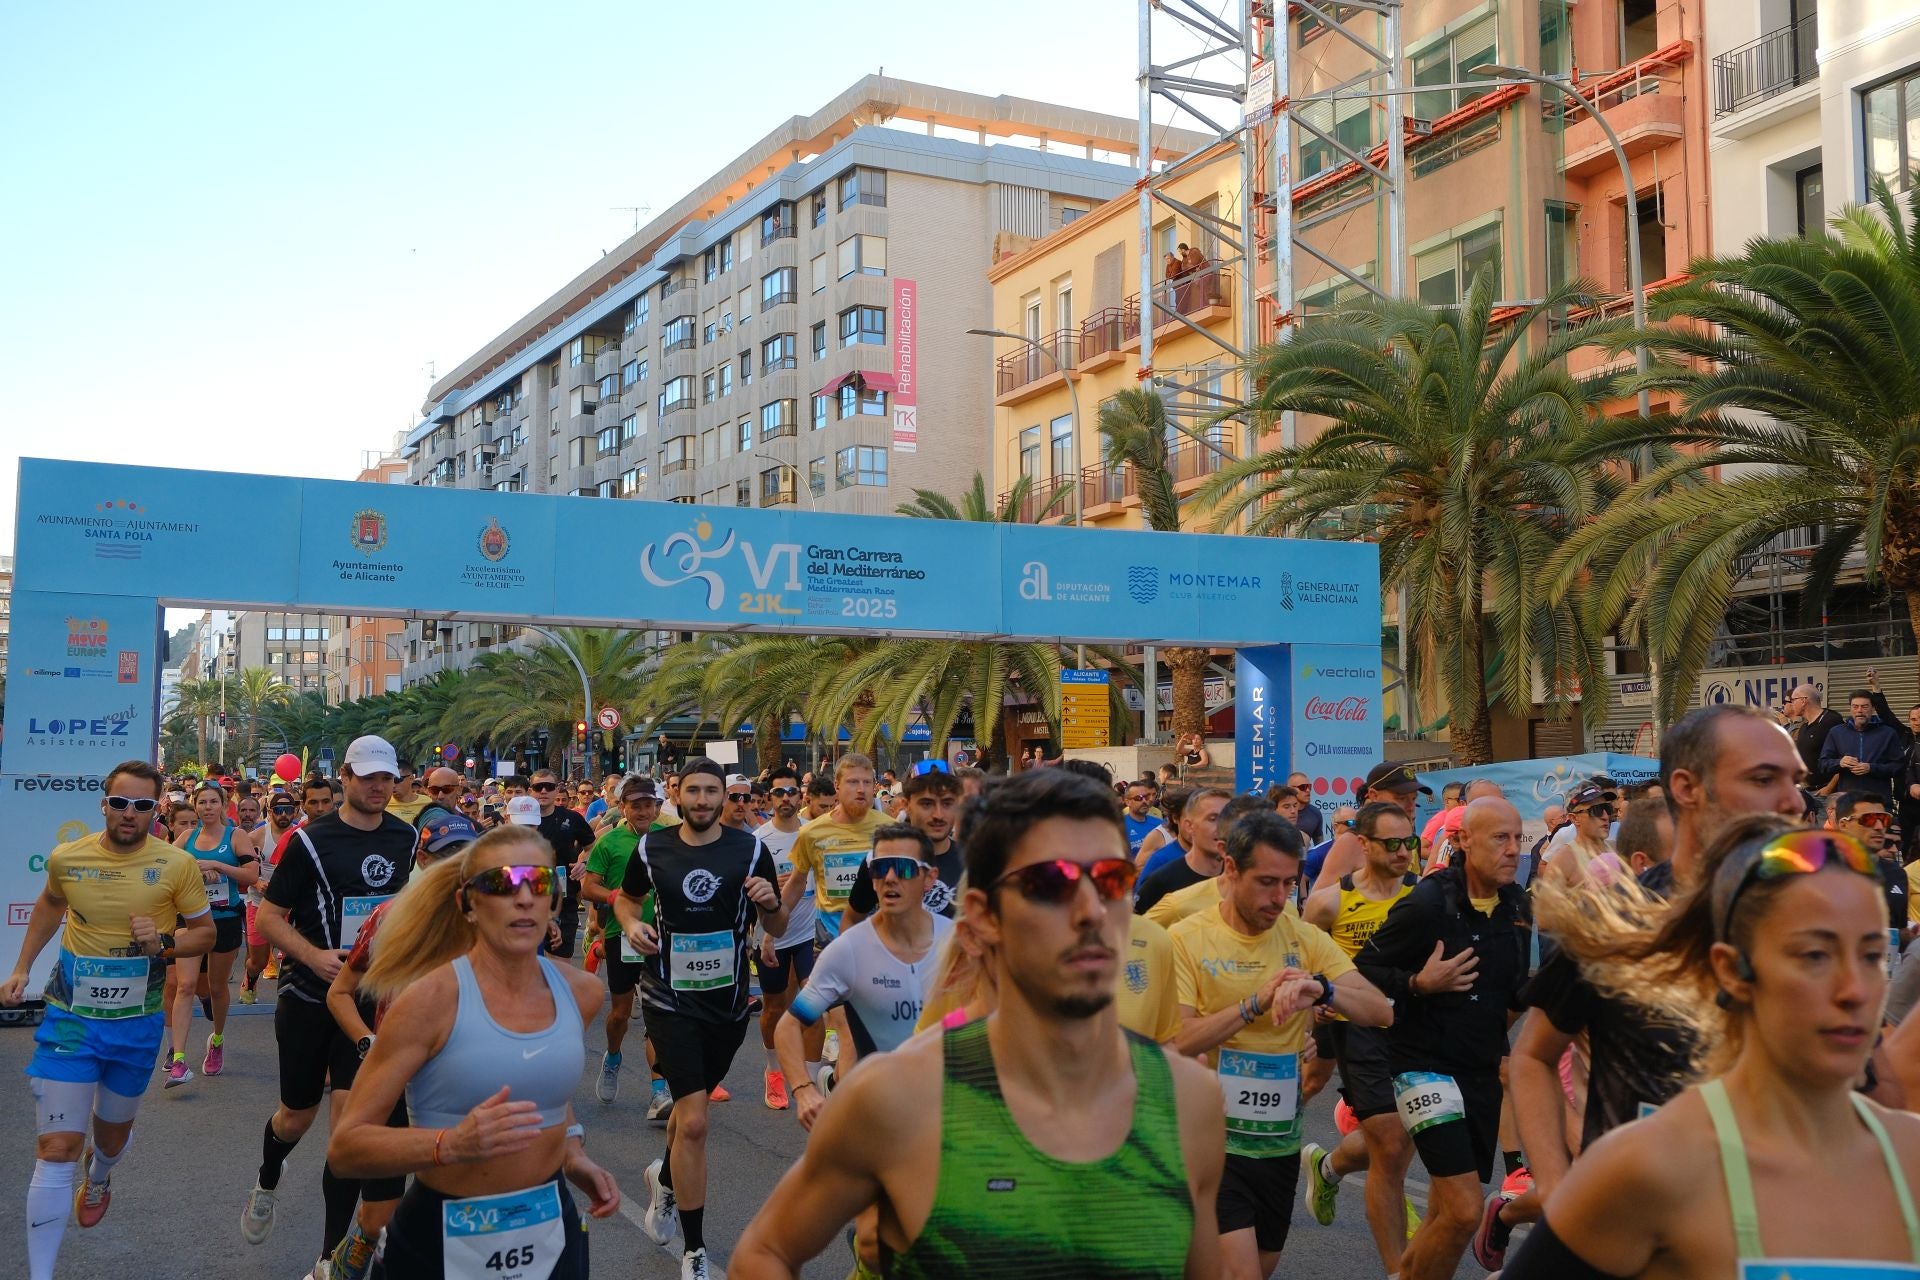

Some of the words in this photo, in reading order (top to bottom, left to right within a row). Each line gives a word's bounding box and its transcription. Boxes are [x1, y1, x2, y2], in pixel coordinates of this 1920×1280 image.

[898, 288, 911, 395] Rehabilitación
[37, 514, 113, 528] AYUNTAMIENTO
[127, 519, 200, 533] AJUNTAMENT
[84, 528, 121, 540] SANTA
[124, 531, 153, 542] POLA
[807, 545, 844, 561] Gran
[846, 547, 903, 564] Carrera
[332, 560, 404, 573] Ayuntamiento
[740, 541, 802, 591] VI
[807, 562, 829, 575] del
[832, 563, 926, 580] Mediterráneo
[340, 571, 353, 580] de
[355, 571, 396, 582] Alicante
[460, 572, 525, 582] AYUNTAMIENTO
[807, 576, 824, 585] The
[826, 577, 864, 587] Greatest
[1169, 573, 1262, 589] MONTEMAR
[486, 581, 511, 589] ELCHE
[807, 584, 872, 595] Mediterranean
[874, 587, 895, 596] Race
[1056, 581, 1110, 592] DIPUTACIÓN
[1296, 581, 1360, 593] GENERALITAT
[1056, 593, 1068, 601] DE
[1070, 593, 1110, 602] ALICANTE
[1298, 593, 1359, 604] VALENCIANA
[841, 597, 897, 618] 2025
[1316, 667, 1376, 679] vectalia
[103, 704, 138, 724] rent
[1305, 696, 1369, 721] Coca-Cola
[29, 718, 129, 736] LOPEZ
[27, 736, 126, 747] Asistencia
[1319, 744, 1332, 755] HLA
[1333, 746, 1373, 755] VISTAHERMOSA
[1611, 769, 1631, 778] Gran
[1315, 799, 1361, 811] Securita
[1345, 921, 1376, 933] SAINTS
[686, 959, 721, 972] 4955
[90, 986, 129, 999] 3877
[1238, 1090, 1281, 1108] 2199
[1406, 1092, 1442, 1115] 3388
[478, 1207, 499, 1225] VI
[486, 1244, 534, 1272] 465
